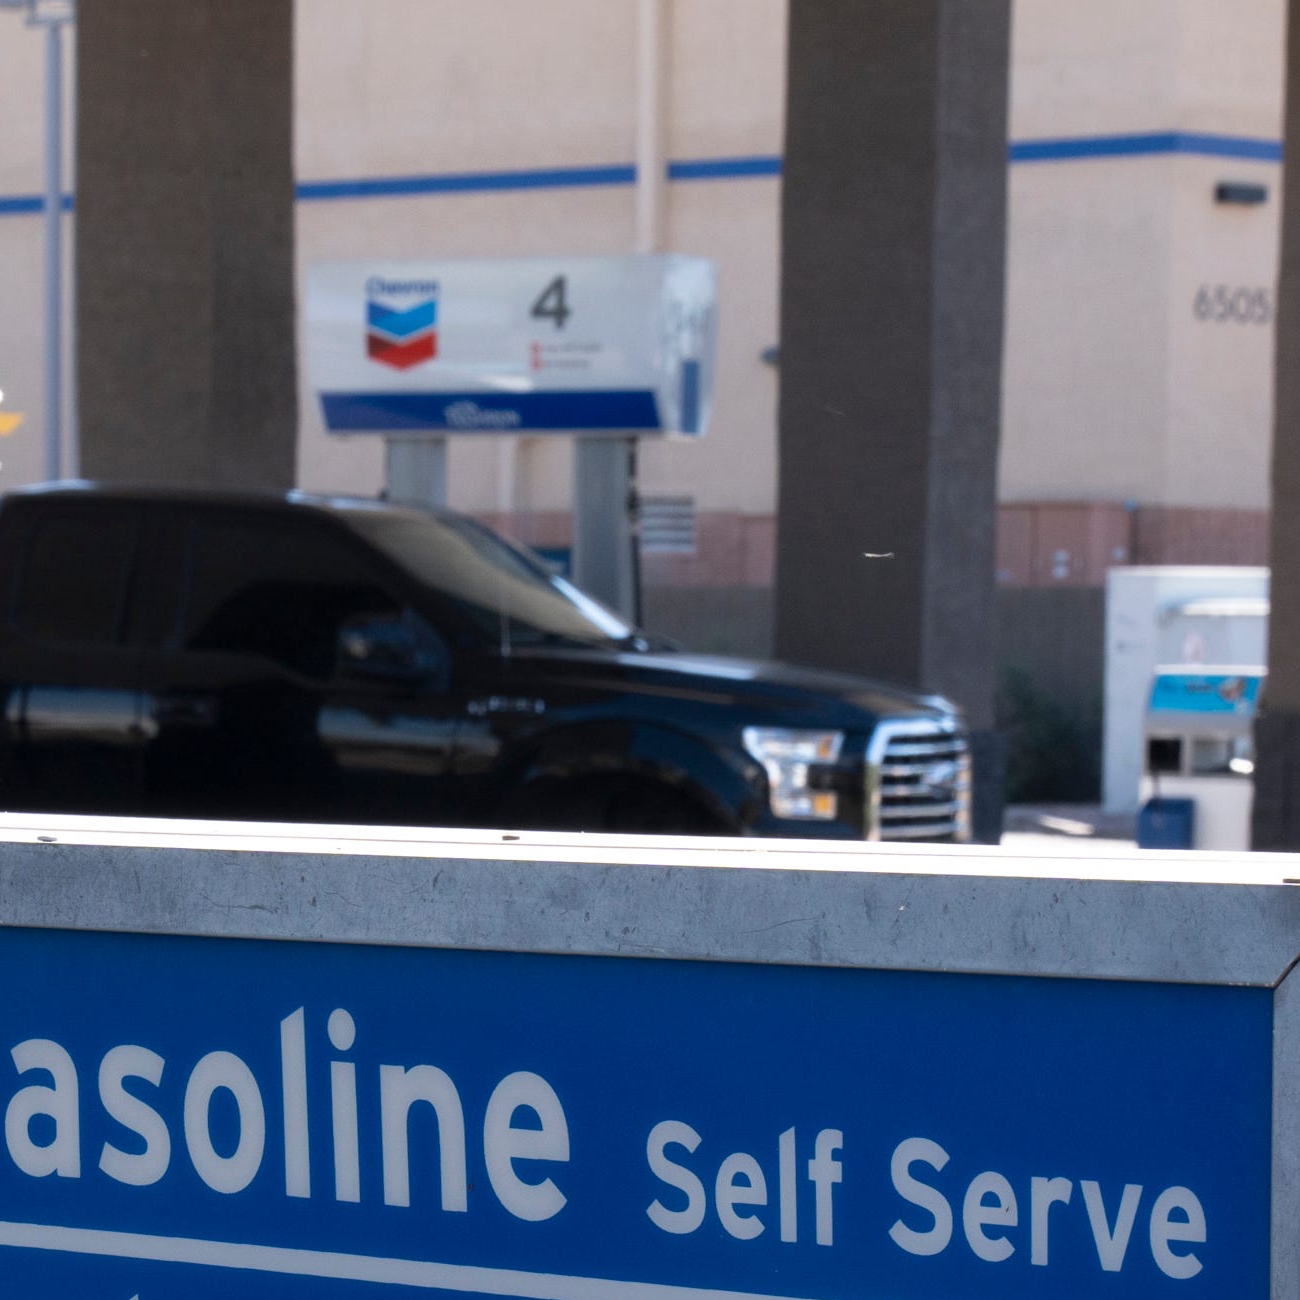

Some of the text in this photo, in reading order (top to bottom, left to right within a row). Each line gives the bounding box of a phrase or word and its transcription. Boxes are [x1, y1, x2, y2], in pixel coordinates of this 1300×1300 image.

[530, 274, 570, 329] 4
[1193, 283, 1273, 324] 6505
[645, 1120, 843, 1247] Self
[888, 1137, 1208, 1280] Serve
